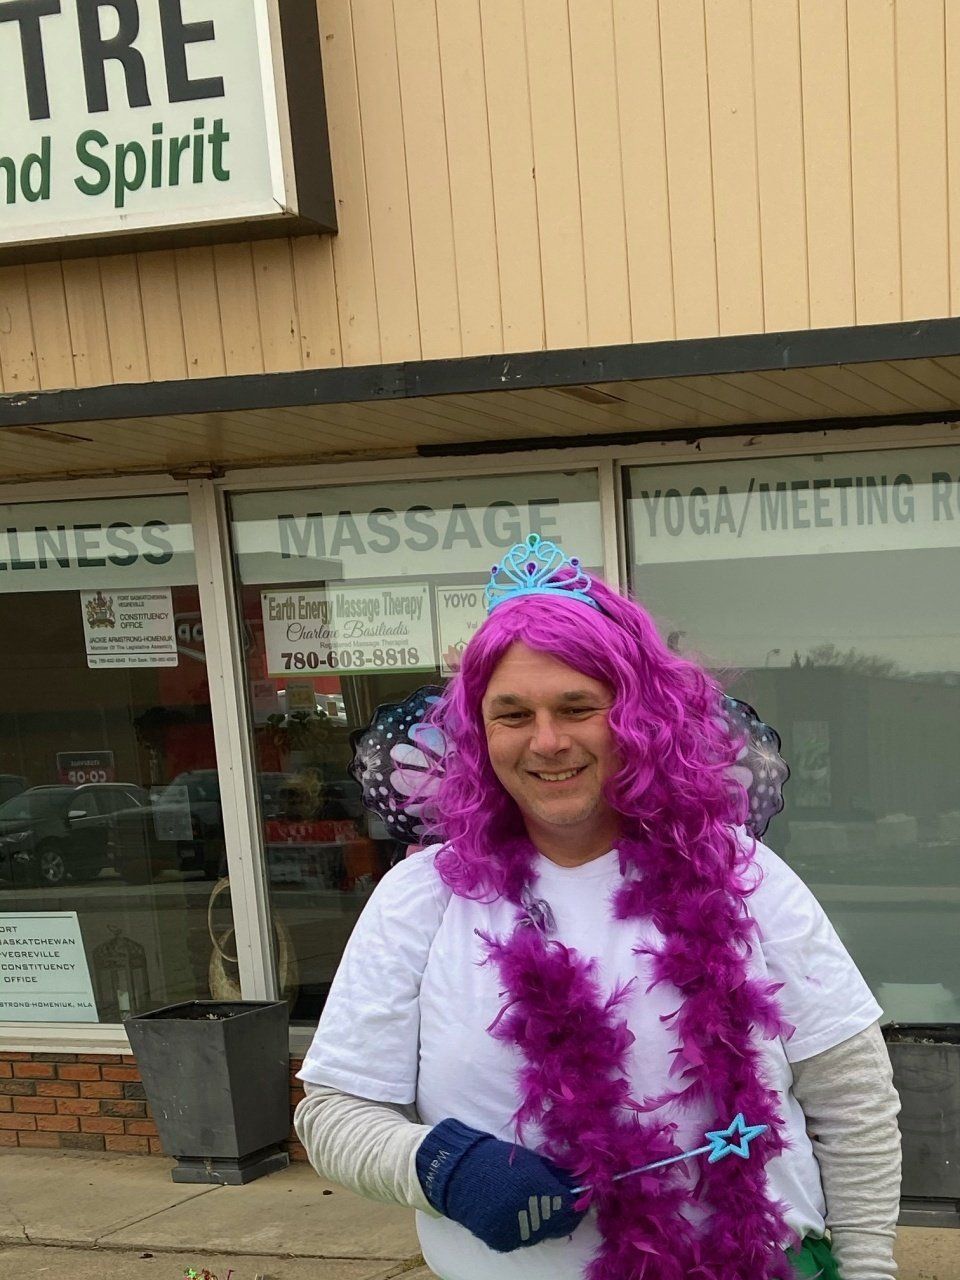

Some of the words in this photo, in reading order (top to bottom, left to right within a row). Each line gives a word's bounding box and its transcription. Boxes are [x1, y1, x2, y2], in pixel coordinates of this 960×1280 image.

[74, 117, 230, 208] Spirit
[641, 475, 915, 539] YOGA/MEETING
[0, 520, 174, 571] LNESS
[278, 497, 562, 560] MASSAGE
[120, 612, 169, 621] CONSTITUENCY
[269, 596, 296, 621] Earth
[298, 595, 333, 625] Energy
[336, 593, 380, 623] Massage
[382, 591, 423, 621] Therapy
[444, 592, 477, 608] YOYO
[286, 622, 340, 642] Charlene
[281, 646, 420, 670] 780-603-8818
